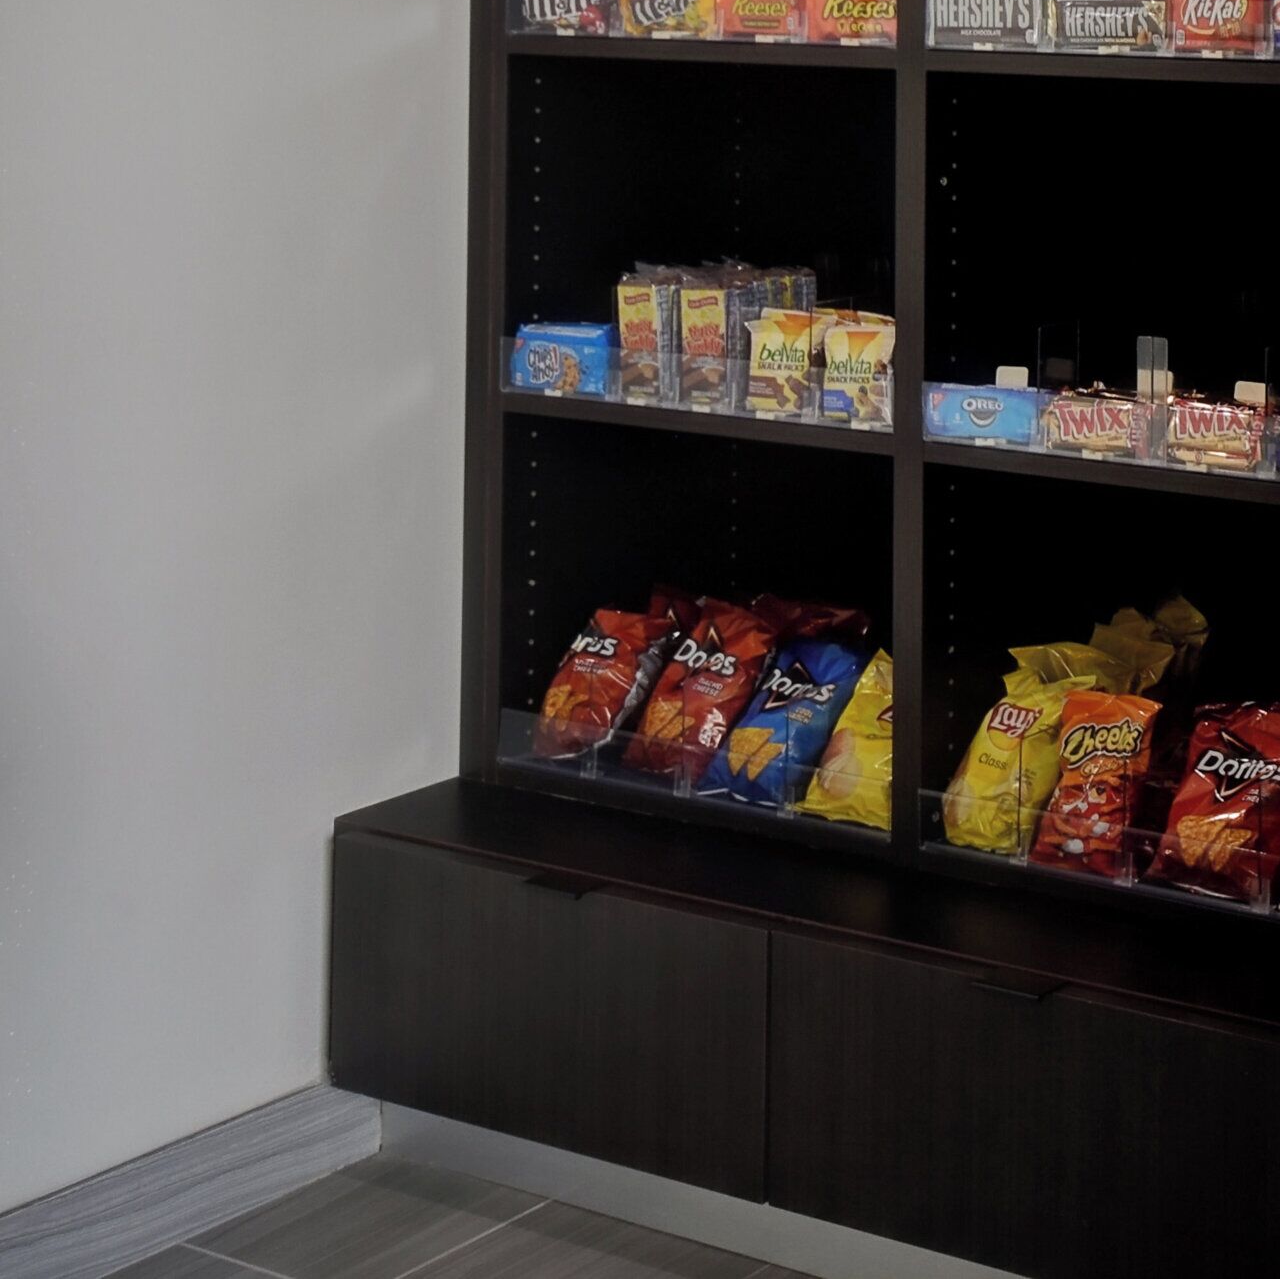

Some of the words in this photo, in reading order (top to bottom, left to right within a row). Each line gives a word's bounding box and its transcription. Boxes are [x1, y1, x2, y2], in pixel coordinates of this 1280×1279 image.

[1065, 5, 1149, 39] HERSHEY'S
[758, 342, 805, 363] belVita
[828, 353, 872, 375] belVita
[827, 375, 848, 384] SNACK
[849, 376, 871, 385] PACKS
[962, 397, 1004, 411] OREO
